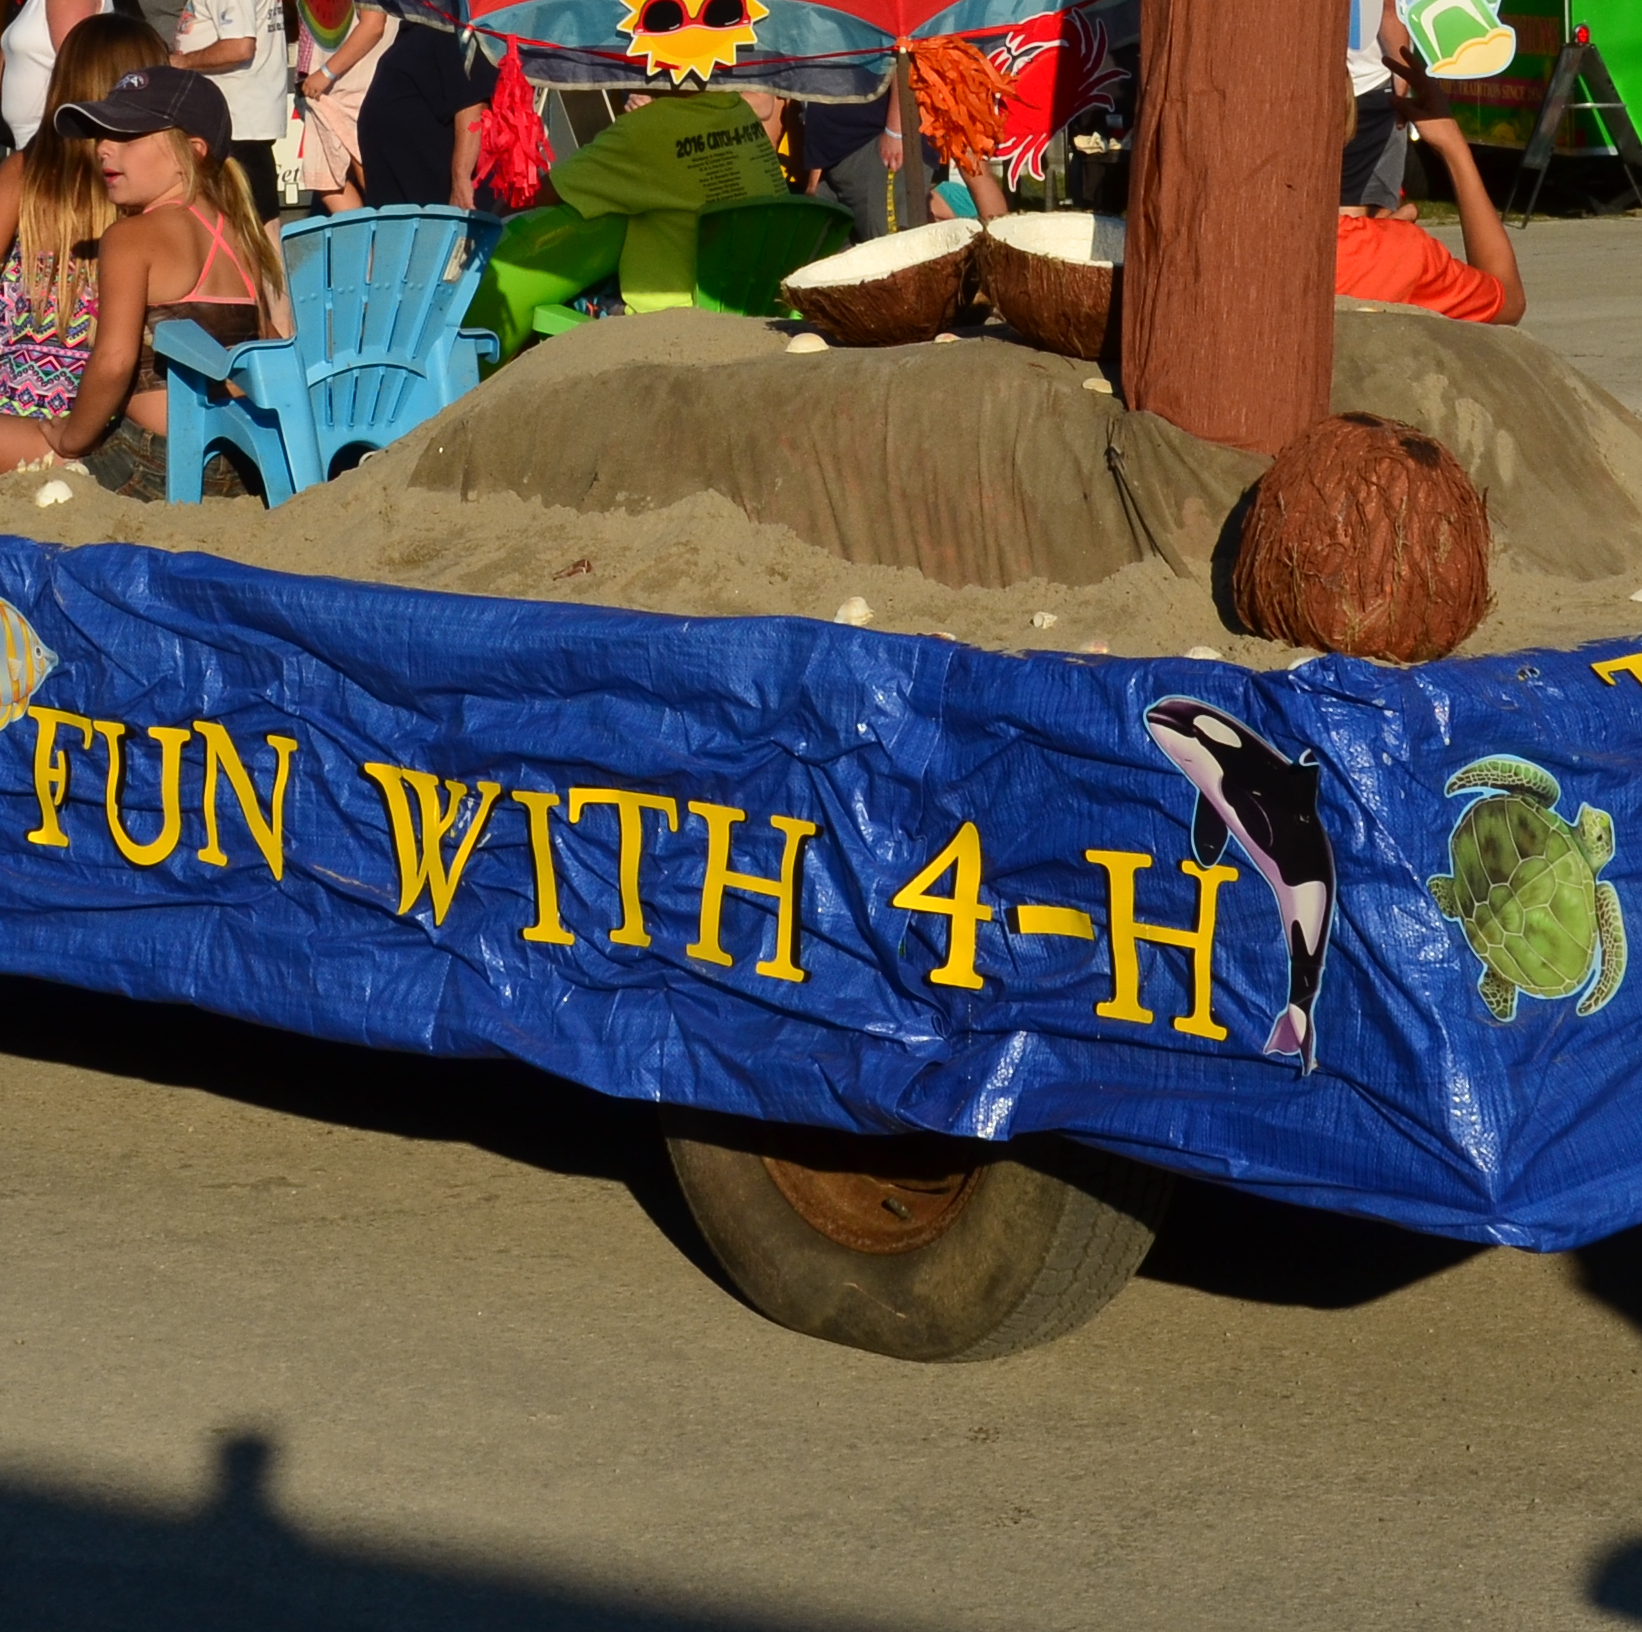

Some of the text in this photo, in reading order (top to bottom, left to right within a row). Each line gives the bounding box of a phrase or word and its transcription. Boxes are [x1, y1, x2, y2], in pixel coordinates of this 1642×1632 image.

[676, 134, 705, 158] 2016
[26, 703, 299, 883] FUN
[364, 759, 822, 984] WITH
[890, 820, 1239, 1042] 4-H
